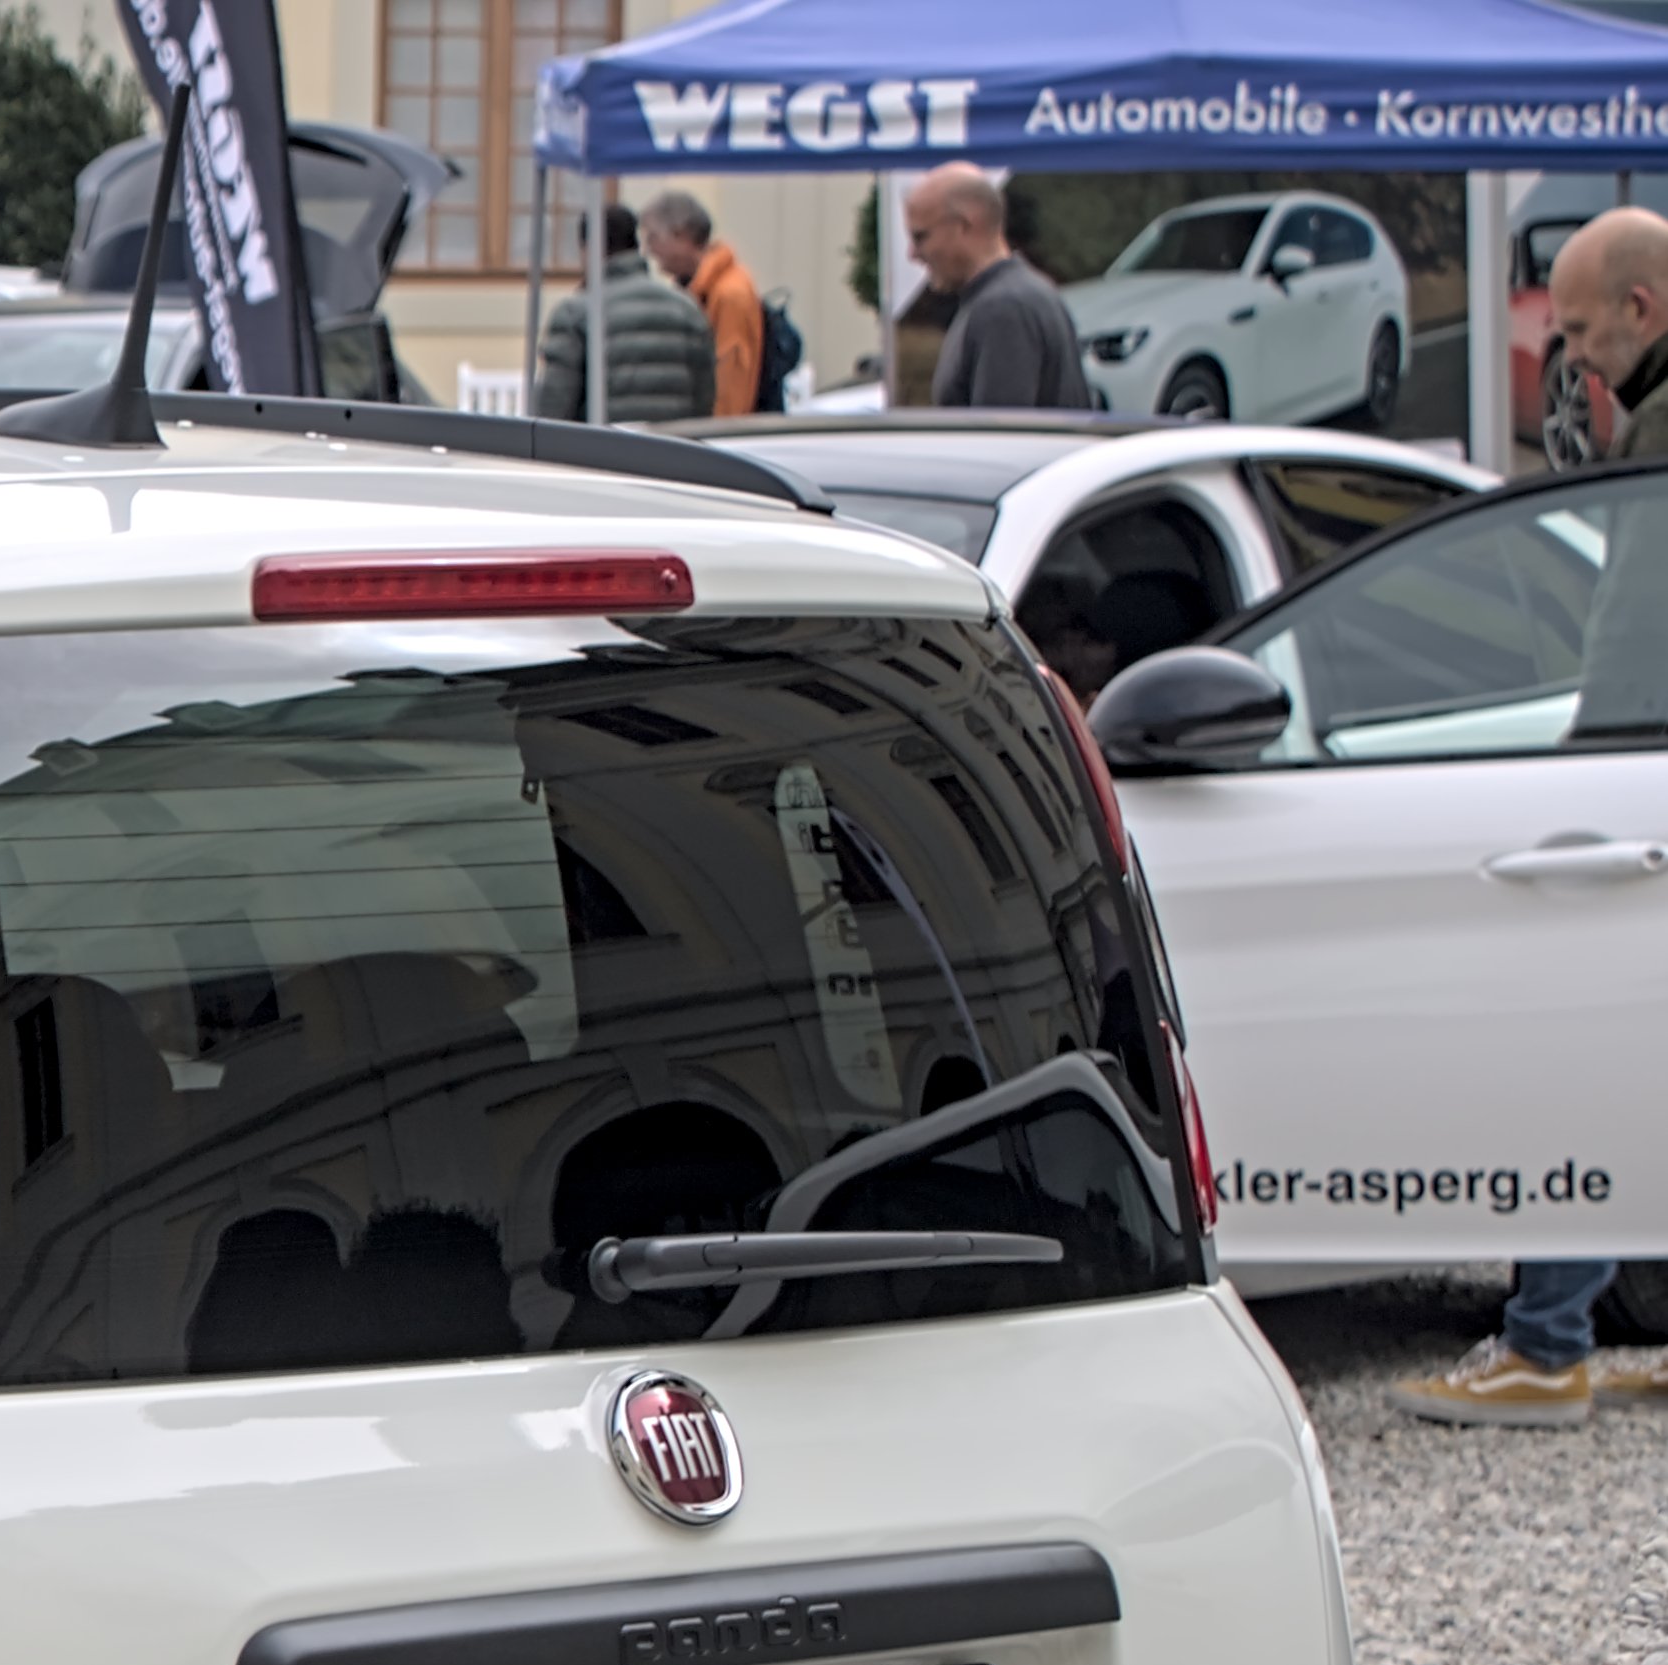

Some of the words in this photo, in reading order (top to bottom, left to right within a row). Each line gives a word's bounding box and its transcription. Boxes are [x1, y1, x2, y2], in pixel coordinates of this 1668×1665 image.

[633, 79, 978, 152] WEGST
[1024, 80, 1329, 135] Automobile
[641, 1411, 722, 1483] FIAT
